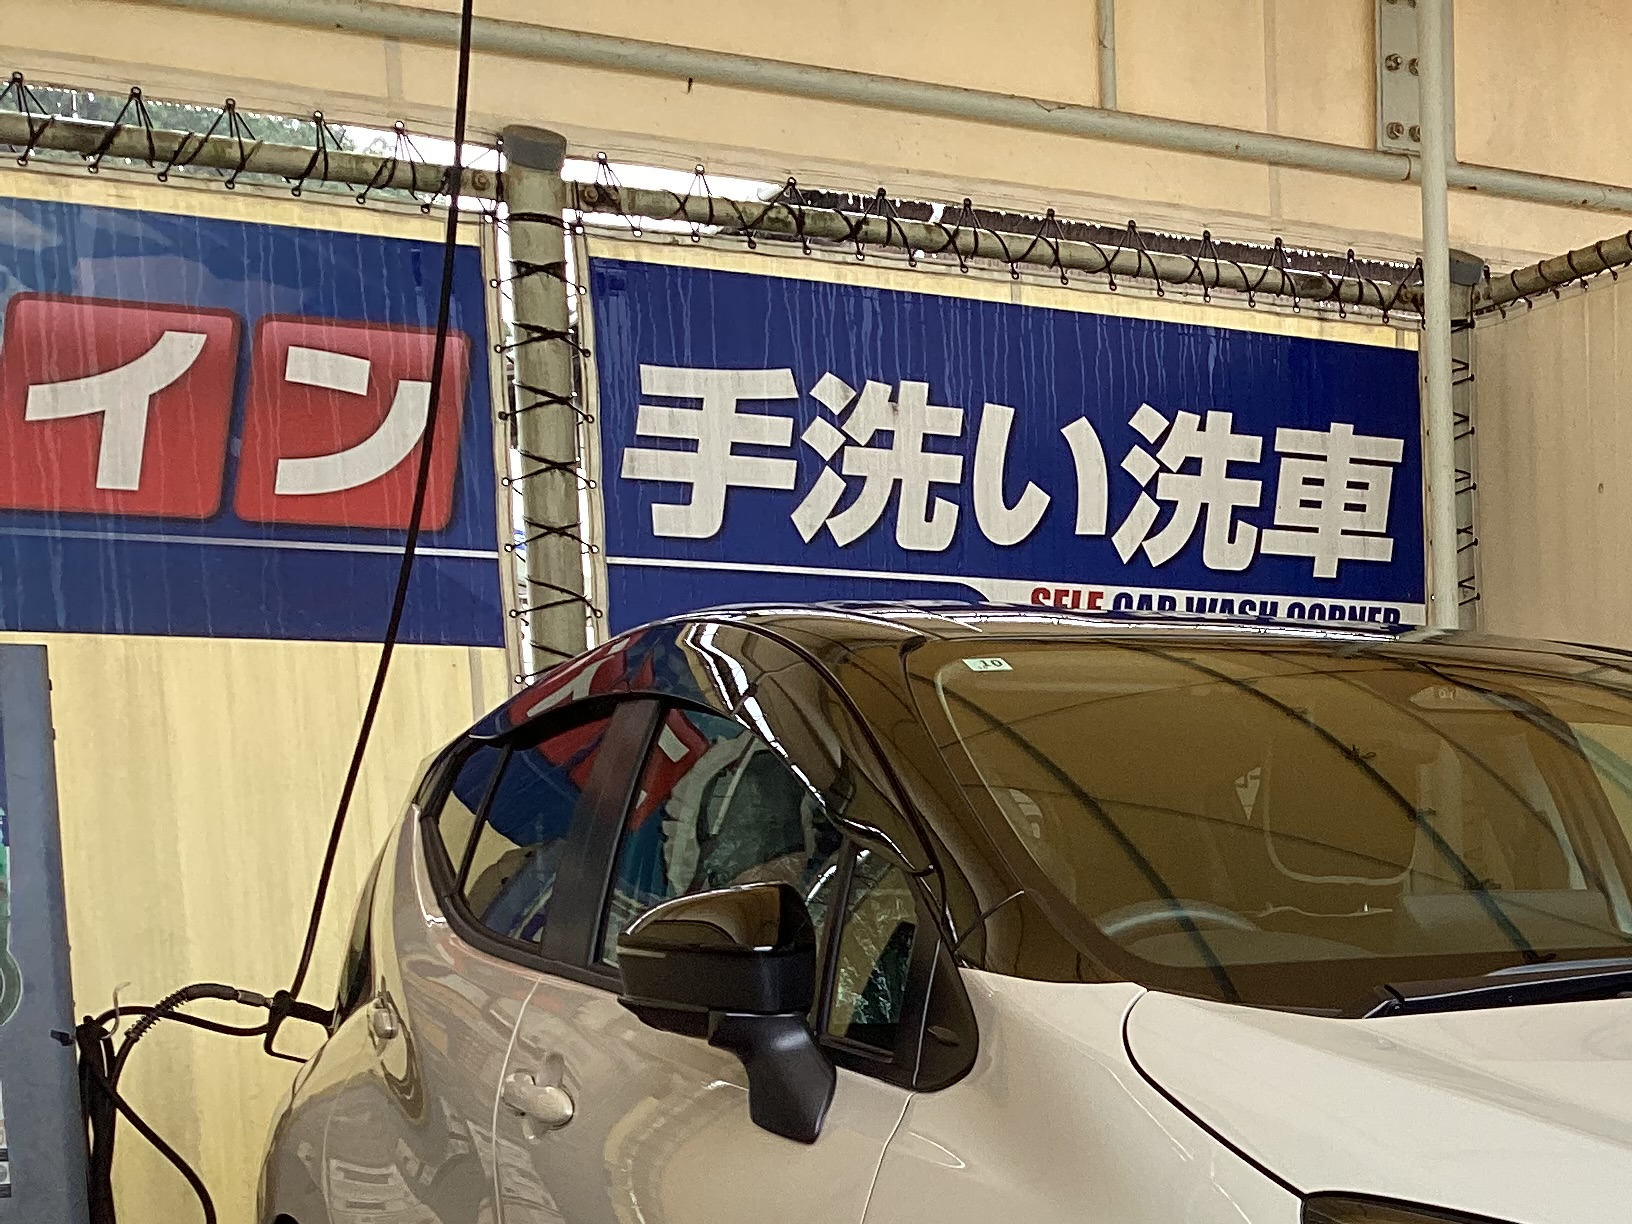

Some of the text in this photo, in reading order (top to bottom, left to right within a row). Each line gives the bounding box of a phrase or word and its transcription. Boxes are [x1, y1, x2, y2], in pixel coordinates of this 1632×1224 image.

[621, 364, 1405, 577] 手洗い洗車
